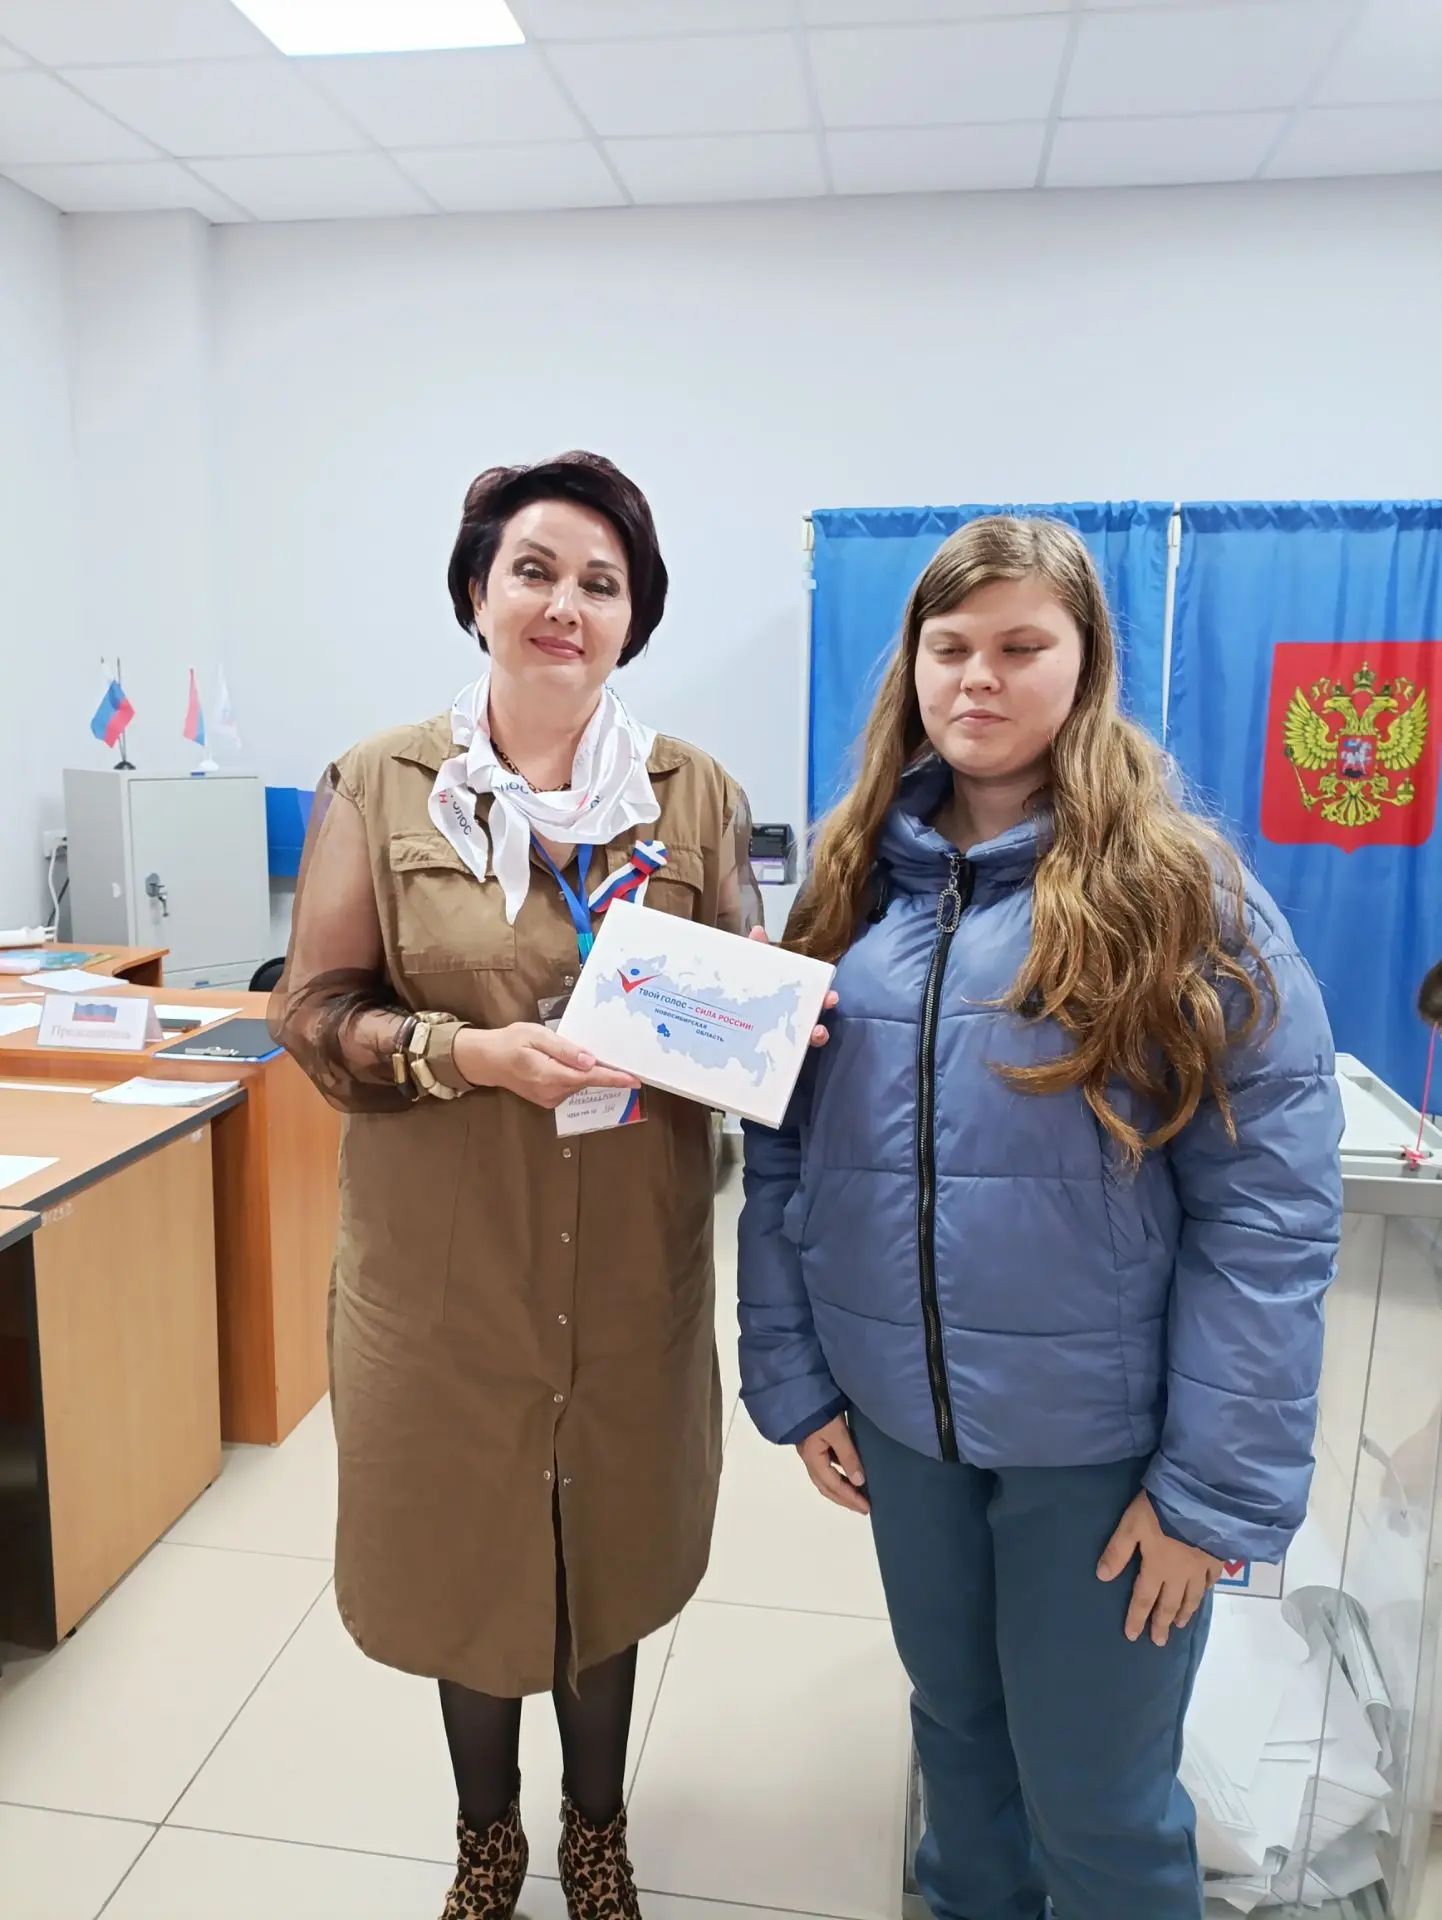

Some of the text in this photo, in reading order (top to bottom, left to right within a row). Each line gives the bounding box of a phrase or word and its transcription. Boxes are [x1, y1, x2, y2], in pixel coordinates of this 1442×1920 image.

[639, 987, 660, 1000] ТВОЙ
[660, 994, 688, 1009] ГОЛОС
[695, 1006, 717, 1019] СИЛА
[718, 1014, 754, 1031] РОССИИ!
[654, 1008, 708, 1030] НОВОСИБИРСКАЯ
[695, 1028, 724, 1042] ОБЛАСТЬ
